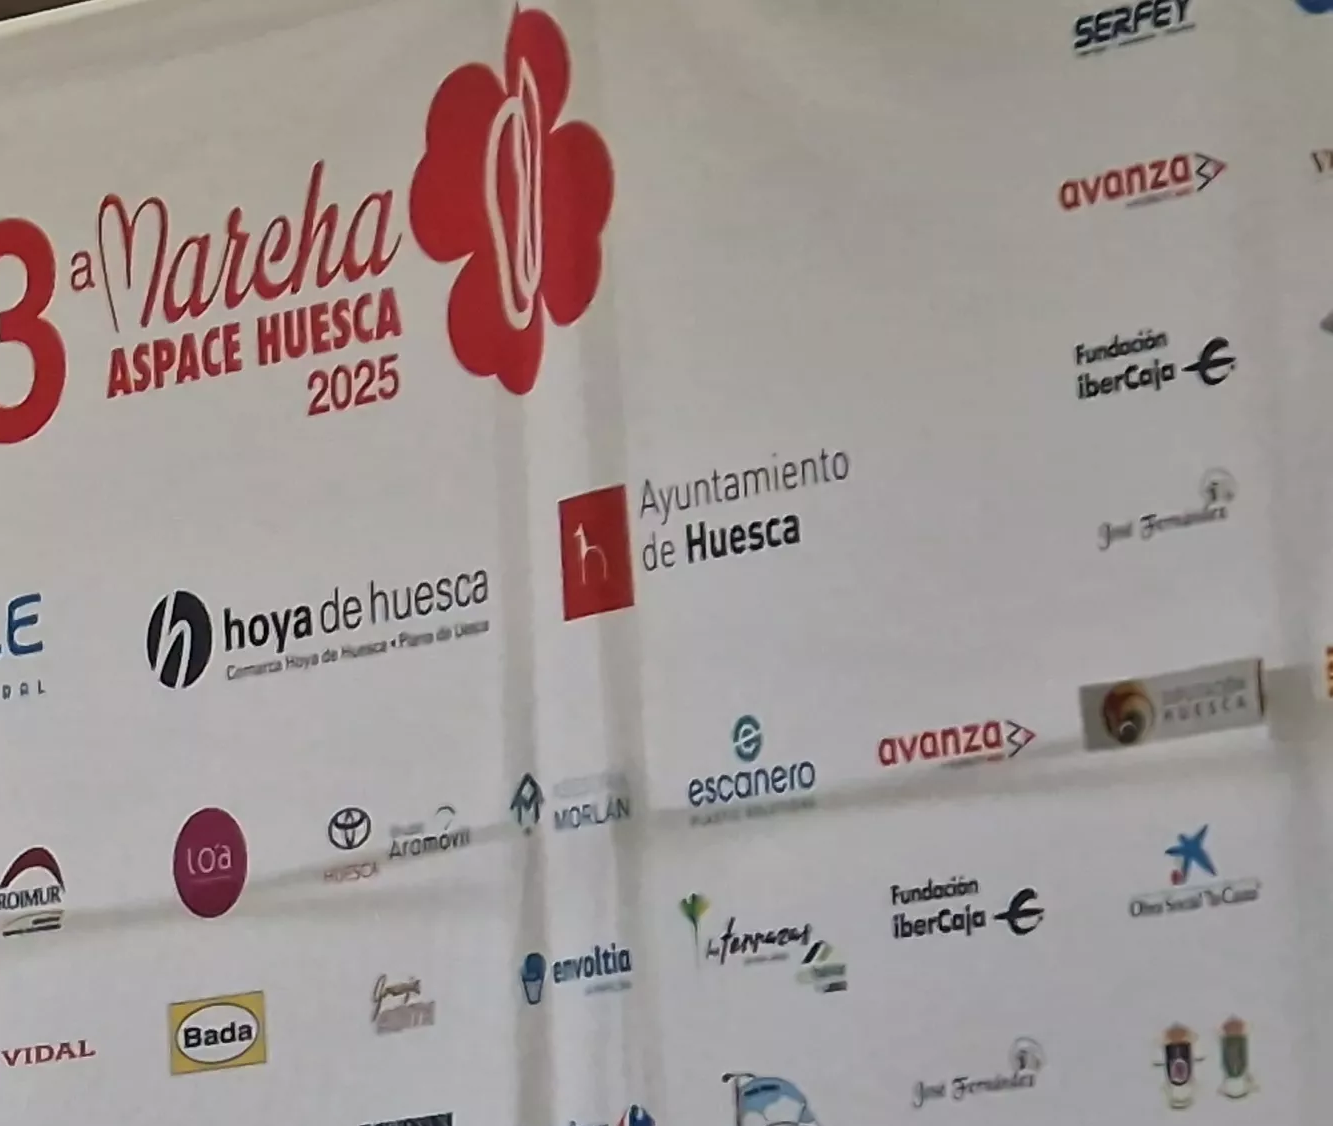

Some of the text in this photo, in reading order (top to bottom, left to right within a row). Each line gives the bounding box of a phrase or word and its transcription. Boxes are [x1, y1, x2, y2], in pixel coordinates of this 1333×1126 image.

[1074, 0, 1192, 49] SERFEY
[1058, 154, 1192, 212] avanza
[97, 159, 404, 333] Marcha
[107, 287, 403, 399] ASPACE HUESCA
[1074, 328, 1170, 367] Fundación
[307, 354, 401, 417] 2025
[638, 448, 852, 524] Ayuntamiento
[641, 509, 803, 574] de Huesca
[222, 567, 491, 660] hoya de huesca
[877, 720, 1003, 768] avanza
[688, 760, 817, 808] escanero
[890, 876, 979, 907] Fundación
[1, 1039, 97, 1068] VIDAL
[183, 1020, 254, 1050] Bada
